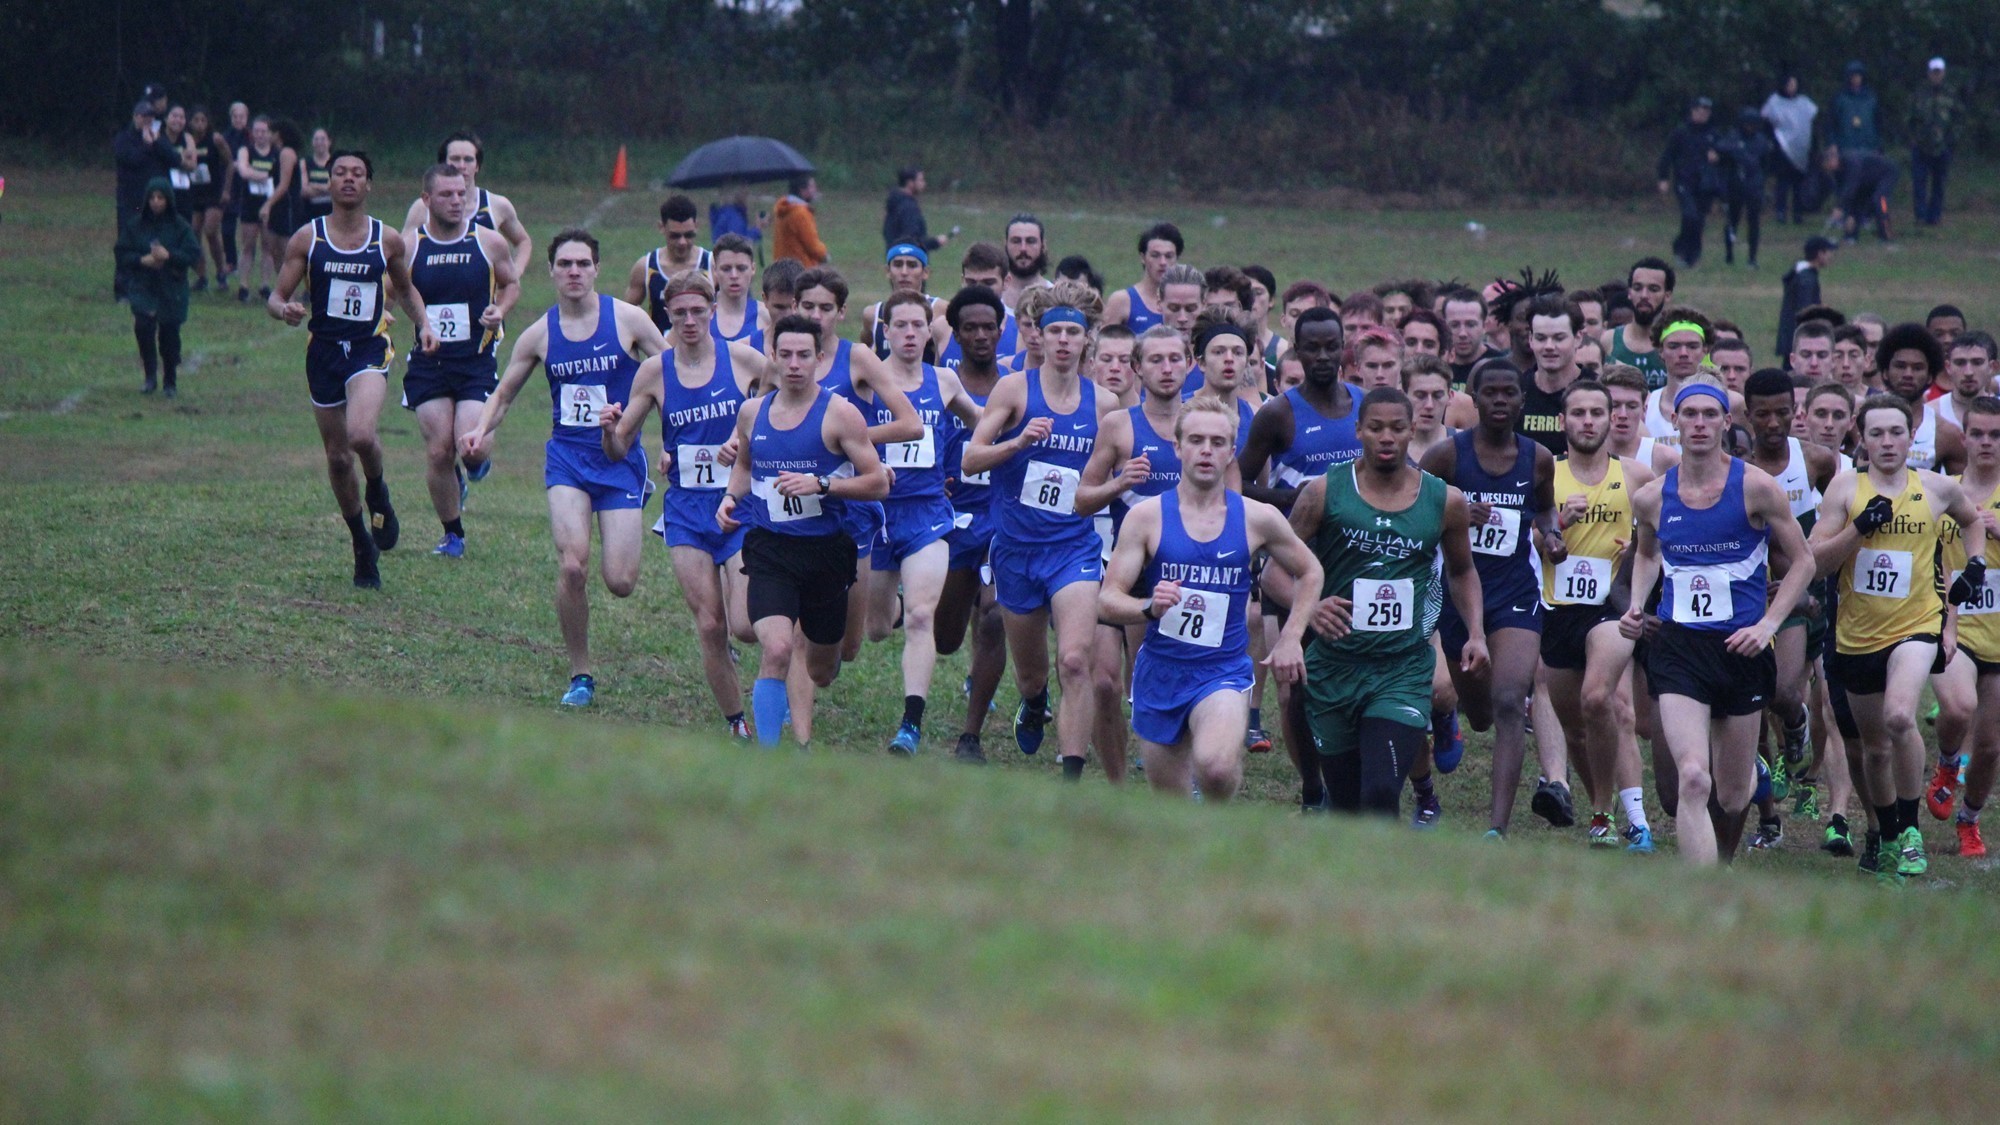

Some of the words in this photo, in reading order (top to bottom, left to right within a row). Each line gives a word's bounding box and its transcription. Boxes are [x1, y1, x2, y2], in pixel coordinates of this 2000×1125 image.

[324, 261, 371, 275] AVERETT
[427, 253, 472, 266] AVERETT
[343, 298, 361, 316] 18
[439, 321, 457, 338] 22
[551, 355, 618, 377] COVENANT
[573, 403, 592, 422] 72
[669, 400, 737, 427] COVENANT
[877, 409, 940, 425] COANT
[902, 444, 920, 462] 77
[1305, 448, 1364, 462] MOUNTAINE
[695, 464, 715, 483] 71
[1141, 471, 1181, 481] OUNTA
[783, 495, 803, 516] 40
[1038, 484, 1061, 507] 68
[1480, 492, 1525, 505] WESLEYAN
[1342, 527, 1423, 550] WILLIAM
[1473, 526, 1508, 550] 187
[1347, 539, 1411, 559] PEACE
[1161, 562, 1242, 585] COVENANT
[1866, 570, 1899, 593] 197
[1565, 576, 1598, 600] 198
[1367, 602, 1402, 626] 259
[1691, 594, 1713, 617] 42
[1179, 612, 1204, 638] 78
